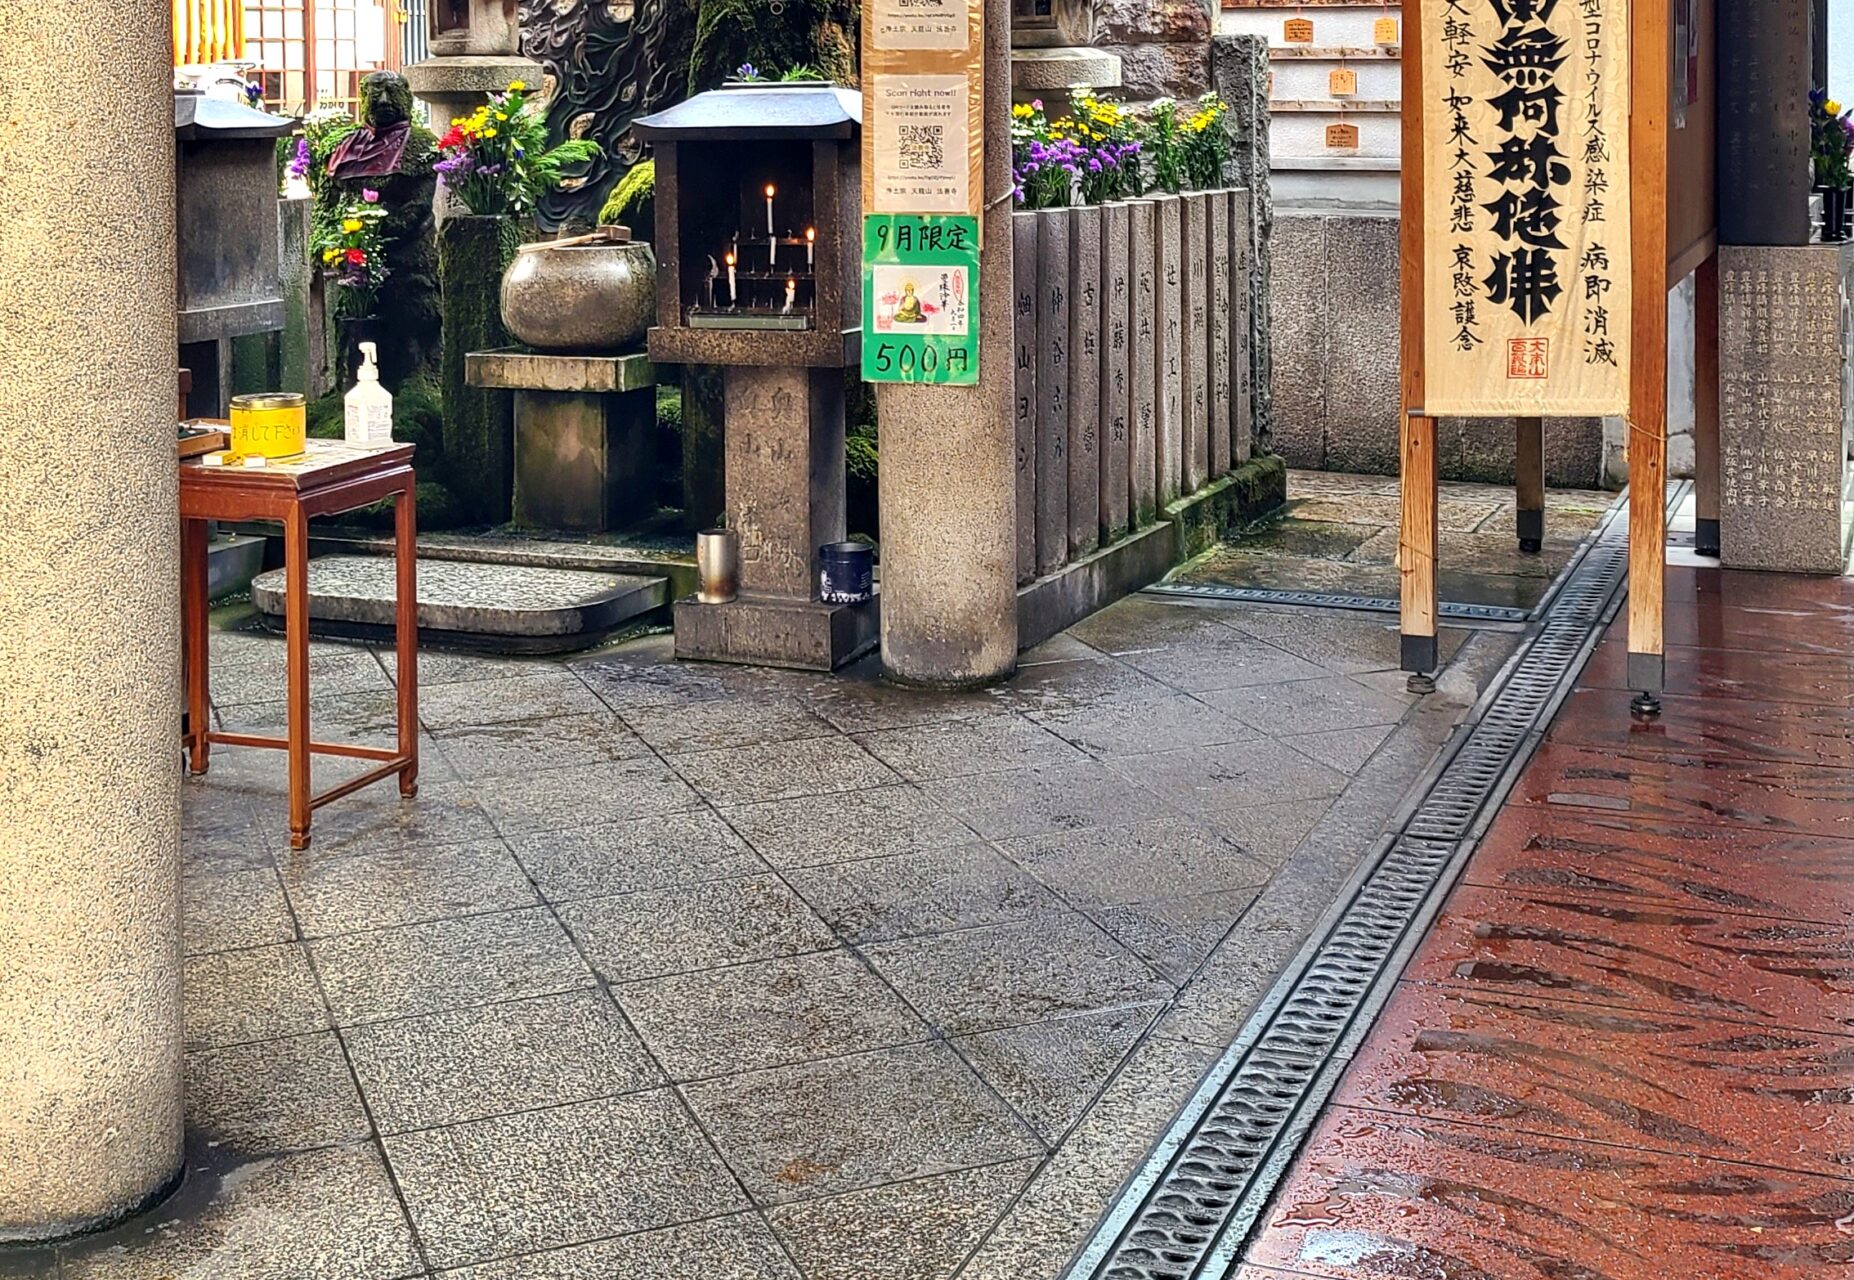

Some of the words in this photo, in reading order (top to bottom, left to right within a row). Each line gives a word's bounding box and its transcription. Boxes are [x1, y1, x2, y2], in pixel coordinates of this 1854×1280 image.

[886, 89, 907, 97] Scan
[909, 89, 931, 98] right
[1441, 88, 1478, 233] 如来大慈悲
[877, 224, 971, 252] 9月限定
[1580, 241, 1618, 367] 病即消滅
[876, 343, 967, 373] 500円
